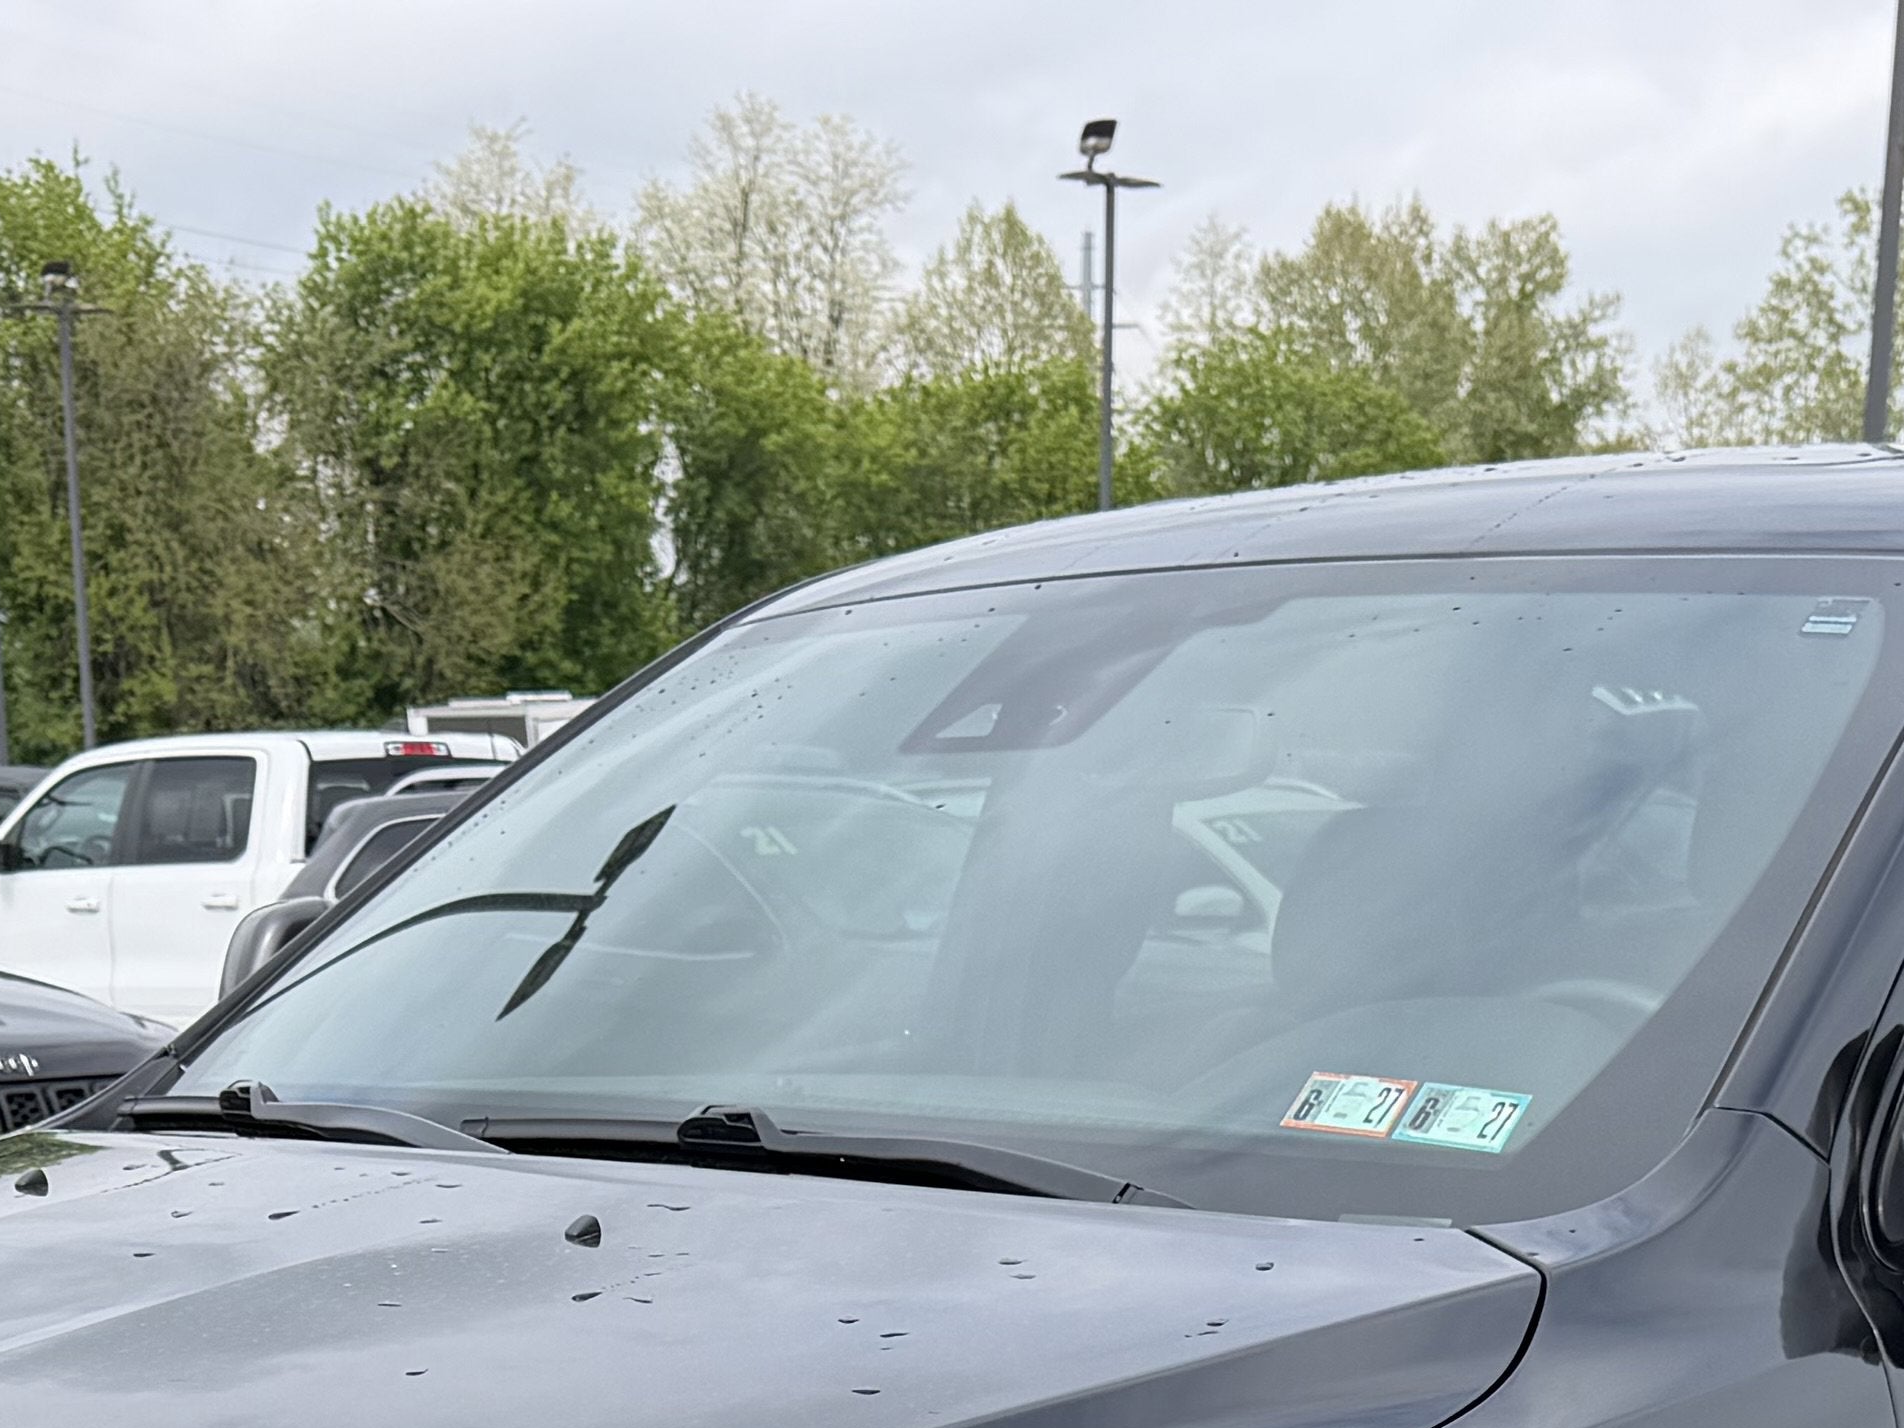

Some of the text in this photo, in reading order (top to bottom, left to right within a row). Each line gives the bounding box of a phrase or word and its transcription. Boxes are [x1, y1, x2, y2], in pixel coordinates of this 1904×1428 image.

[740, 826, 799, 855] 21
[1293, 1087, 1405, 1128] 6 27
[1408, 1097, 1519, 1142] 6 27
